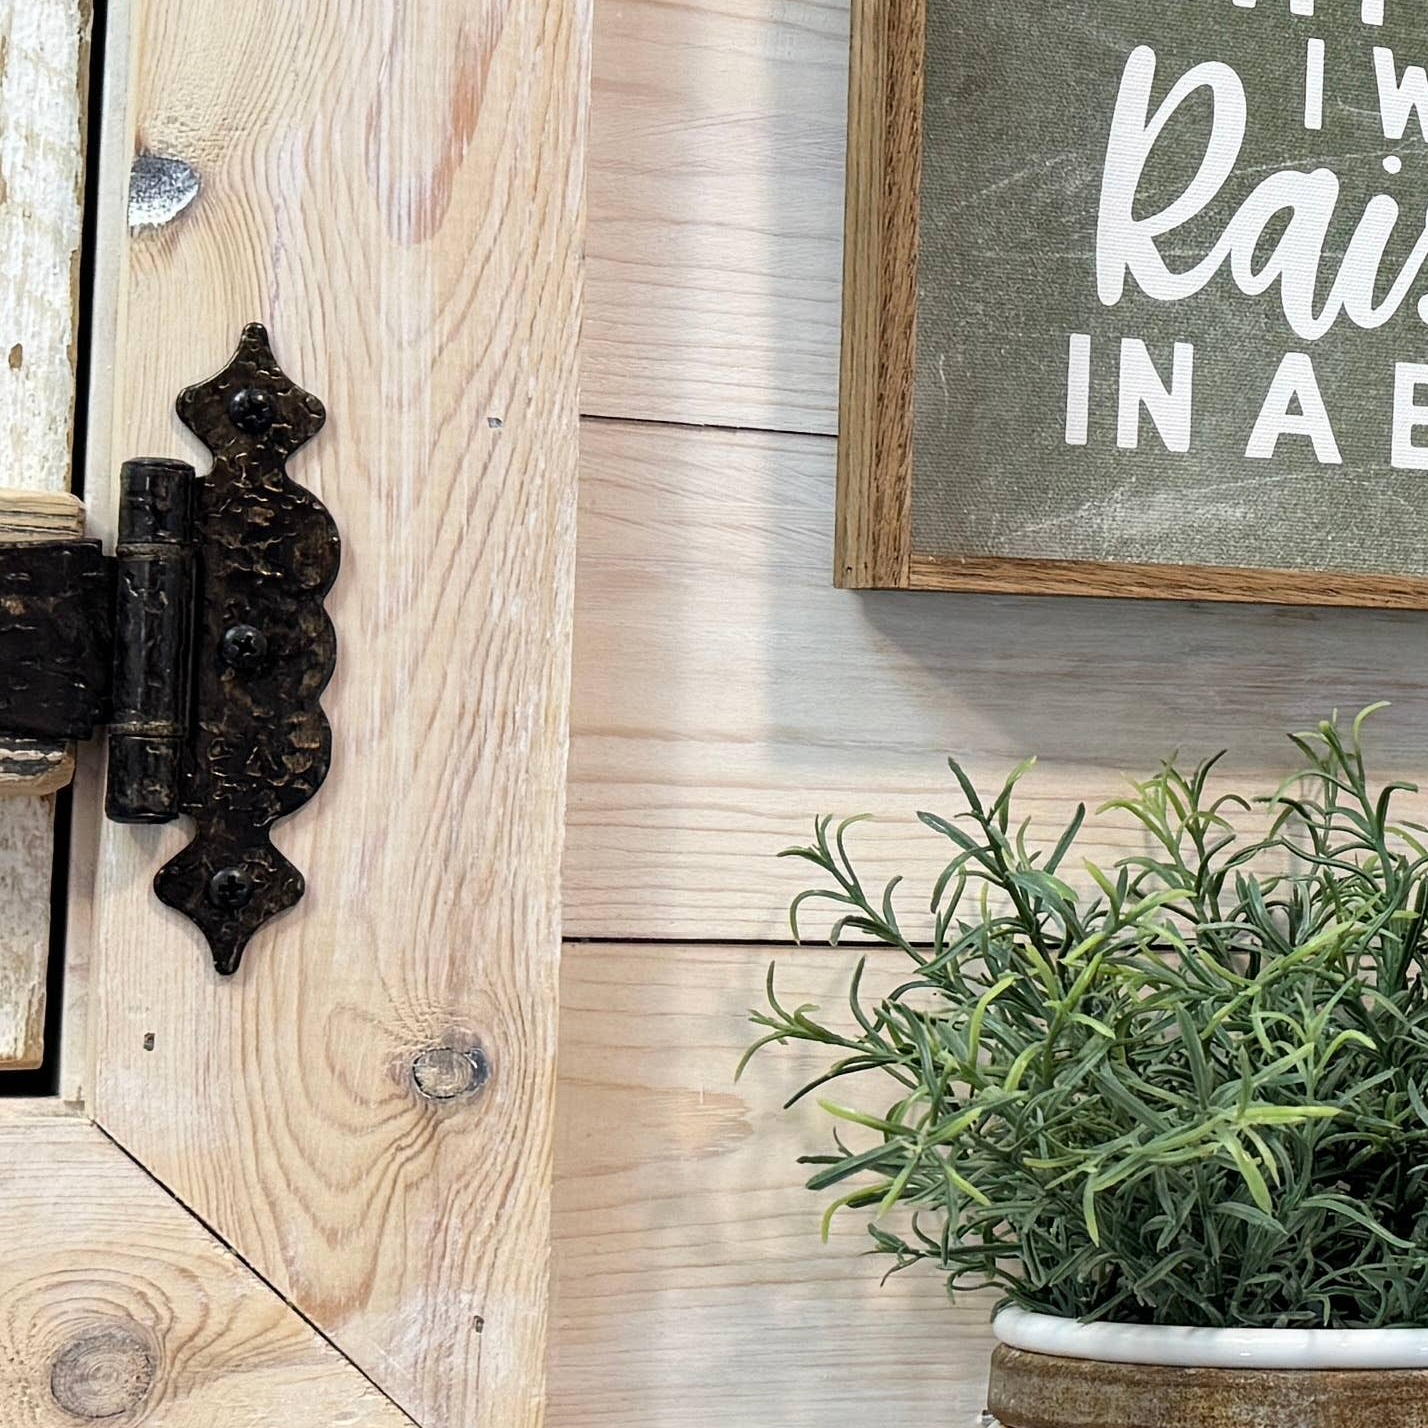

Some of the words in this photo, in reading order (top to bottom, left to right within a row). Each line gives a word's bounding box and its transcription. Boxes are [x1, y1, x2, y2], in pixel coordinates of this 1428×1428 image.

[1303, 37, 1325, 131] I
[1064, 332, 1195, 454] IN
[1243, 351, 1344, 466] A
